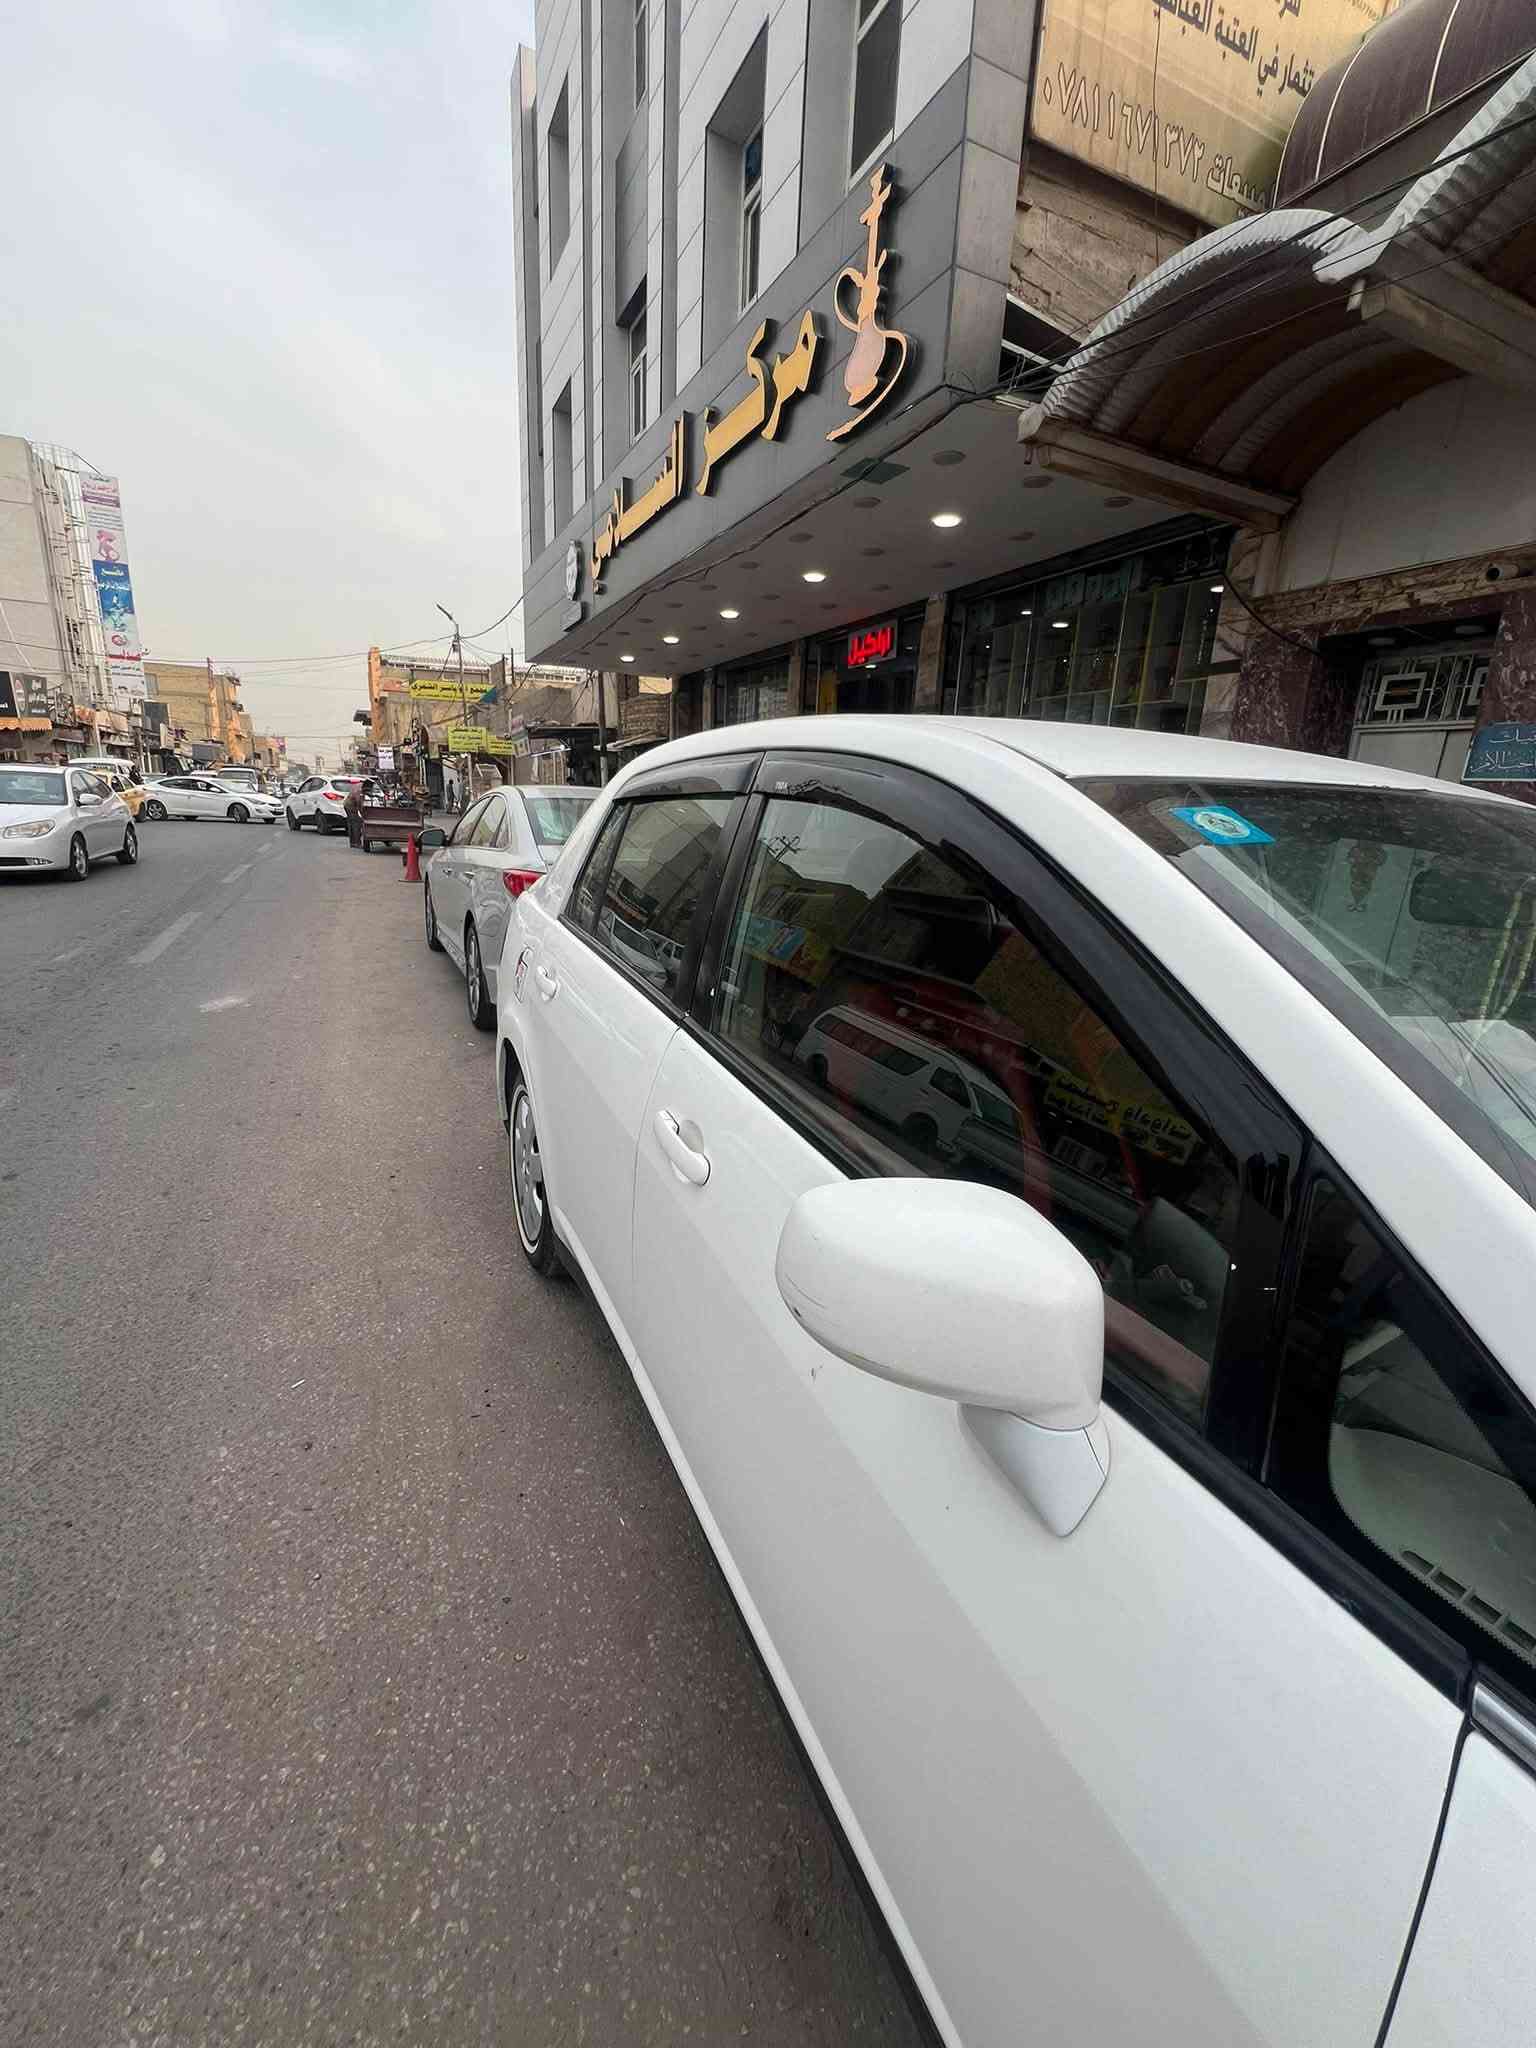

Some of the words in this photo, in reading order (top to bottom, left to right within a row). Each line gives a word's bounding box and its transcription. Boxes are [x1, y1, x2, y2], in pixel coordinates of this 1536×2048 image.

[1214, 5, 1260, 64] العتبة
[1256, 44, 1280, 97] في
[696, 309, 820, 497] مركز
